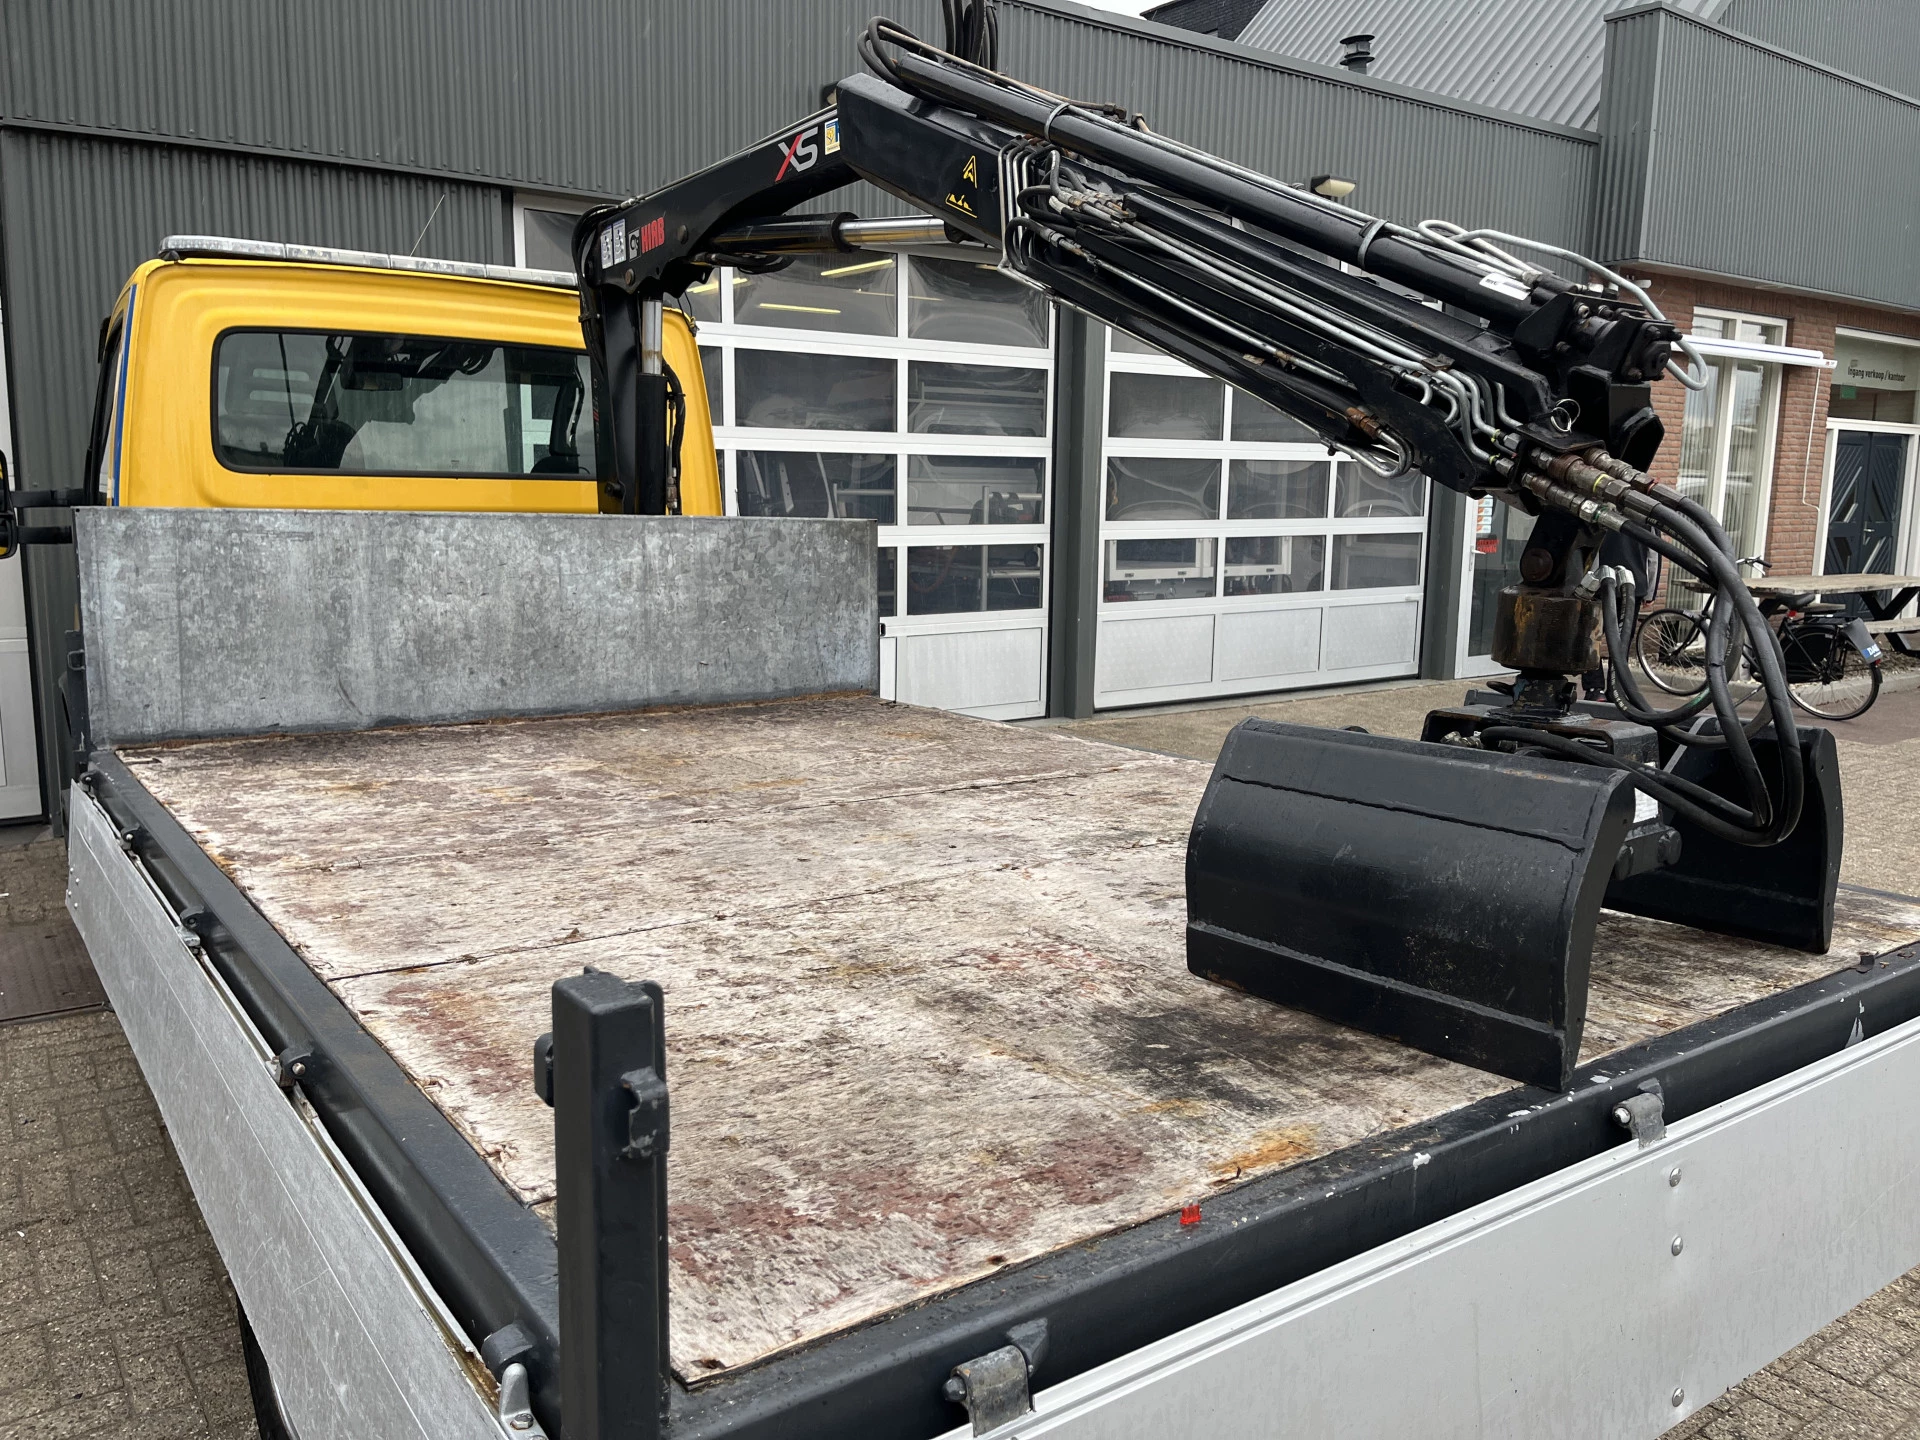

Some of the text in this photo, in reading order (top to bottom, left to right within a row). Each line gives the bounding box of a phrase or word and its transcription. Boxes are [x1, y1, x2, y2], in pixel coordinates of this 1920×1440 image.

[775, 126, 818, 183] XS
[641, 217, 665, 254] HIAB
[1847, 366, 1865, 379] Ingang
[1865, 369, 1884, 381] verkoop
[1888, 371, 1906, 382] kantoor
